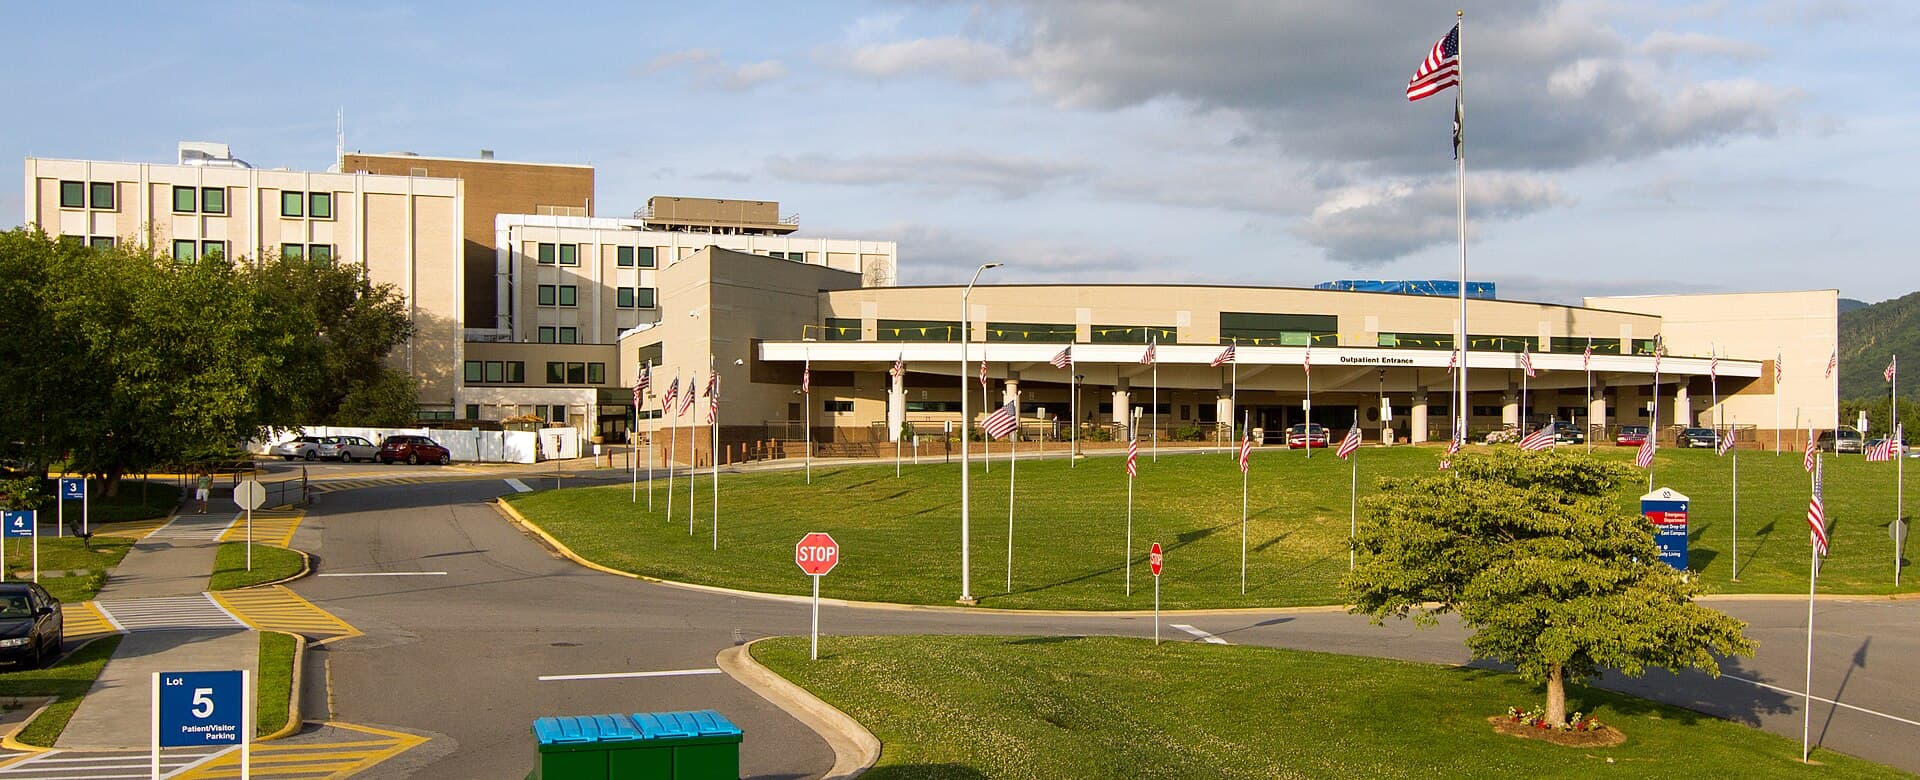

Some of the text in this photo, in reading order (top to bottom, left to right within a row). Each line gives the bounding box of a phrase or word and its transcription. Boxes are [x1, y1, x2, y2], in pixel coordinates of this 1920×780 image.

[1340, 356, 1379, 364] Outpatient
[70, 483, 77, 492] 3
[14, 516, 24, 527] 4
[799, 546, 835, 562] STOP
[1151, 553, 1161, 565] STOP
[166, 677, 183, 686] Lot
[191, 687, 214, 718] 5
